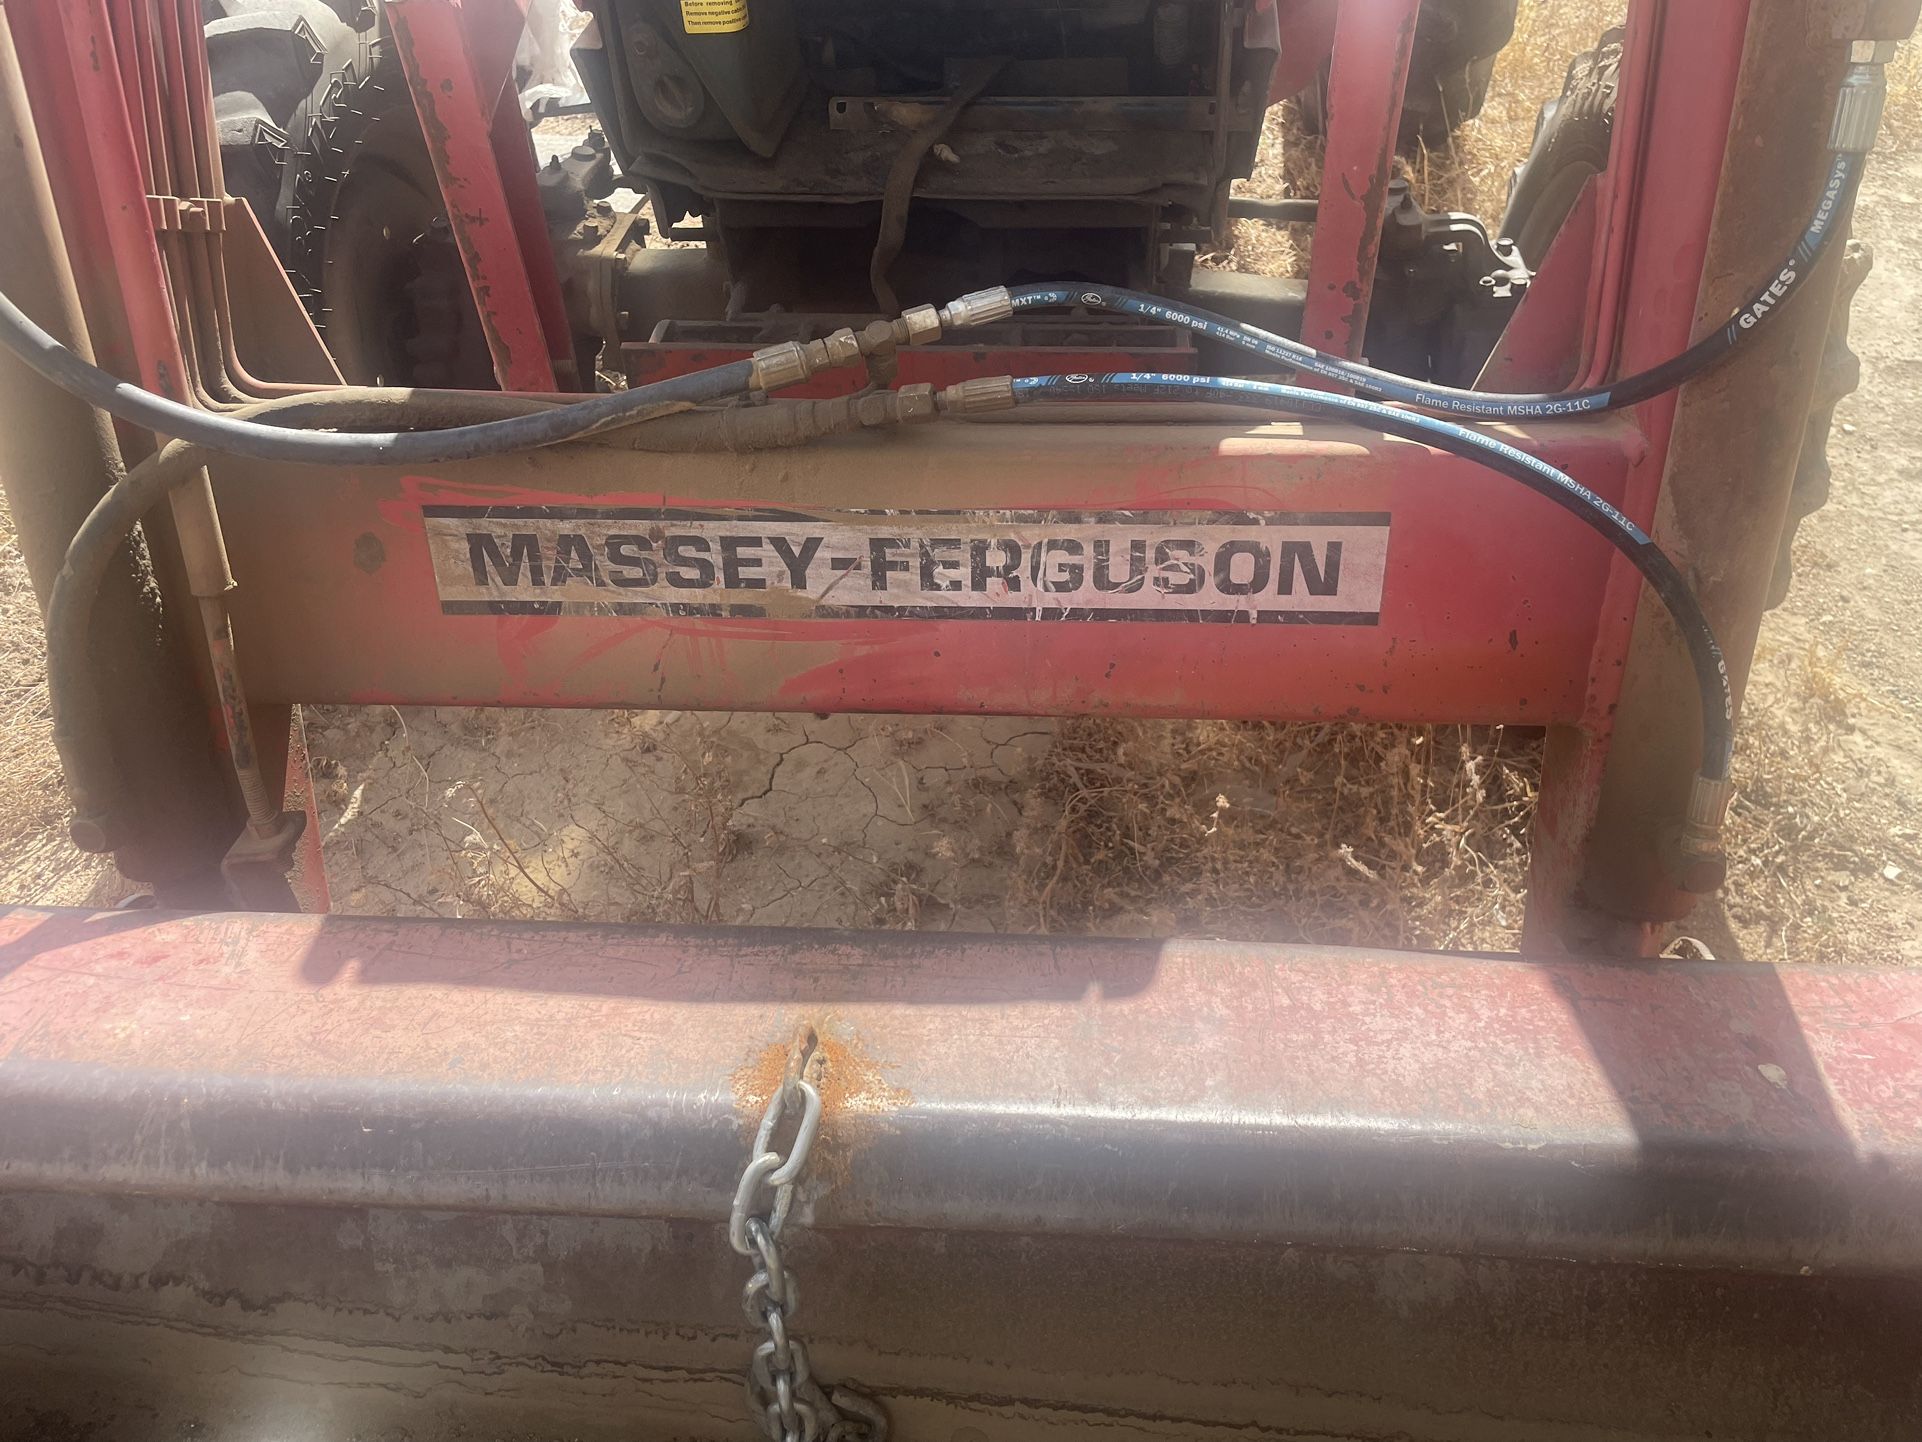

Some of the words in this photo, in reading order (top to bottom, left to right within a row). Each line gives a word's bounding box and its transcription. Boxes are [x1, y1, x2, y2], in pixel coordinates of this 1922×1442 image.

[722, 17, 742, 26] positive
[1738, 267, 1797, 330] GATES
[1165, 310, 1191, 325] 6000
[1191, 319, 1208, 331] psi
[1161, 373, 1190, 382] 6000
[1192, 375, 1211, 384] psi
[1415, 392, 1449, 409] Flame
[1451, 400, 1504, 416] Resistant
[1507, 404, 1543, 416] MSHA
[1545, 399, 1591, 415] 2G-11C
[1458, 428, 1497, 449] Flame
[1499, 444, 1556, 478] Resistant
[1556, 470, 1592, 500] MSHA
[1593, 495, 1636, 532] 2G-11C
[466, 532, 1343, 597] MASSEY-FERGUSON
